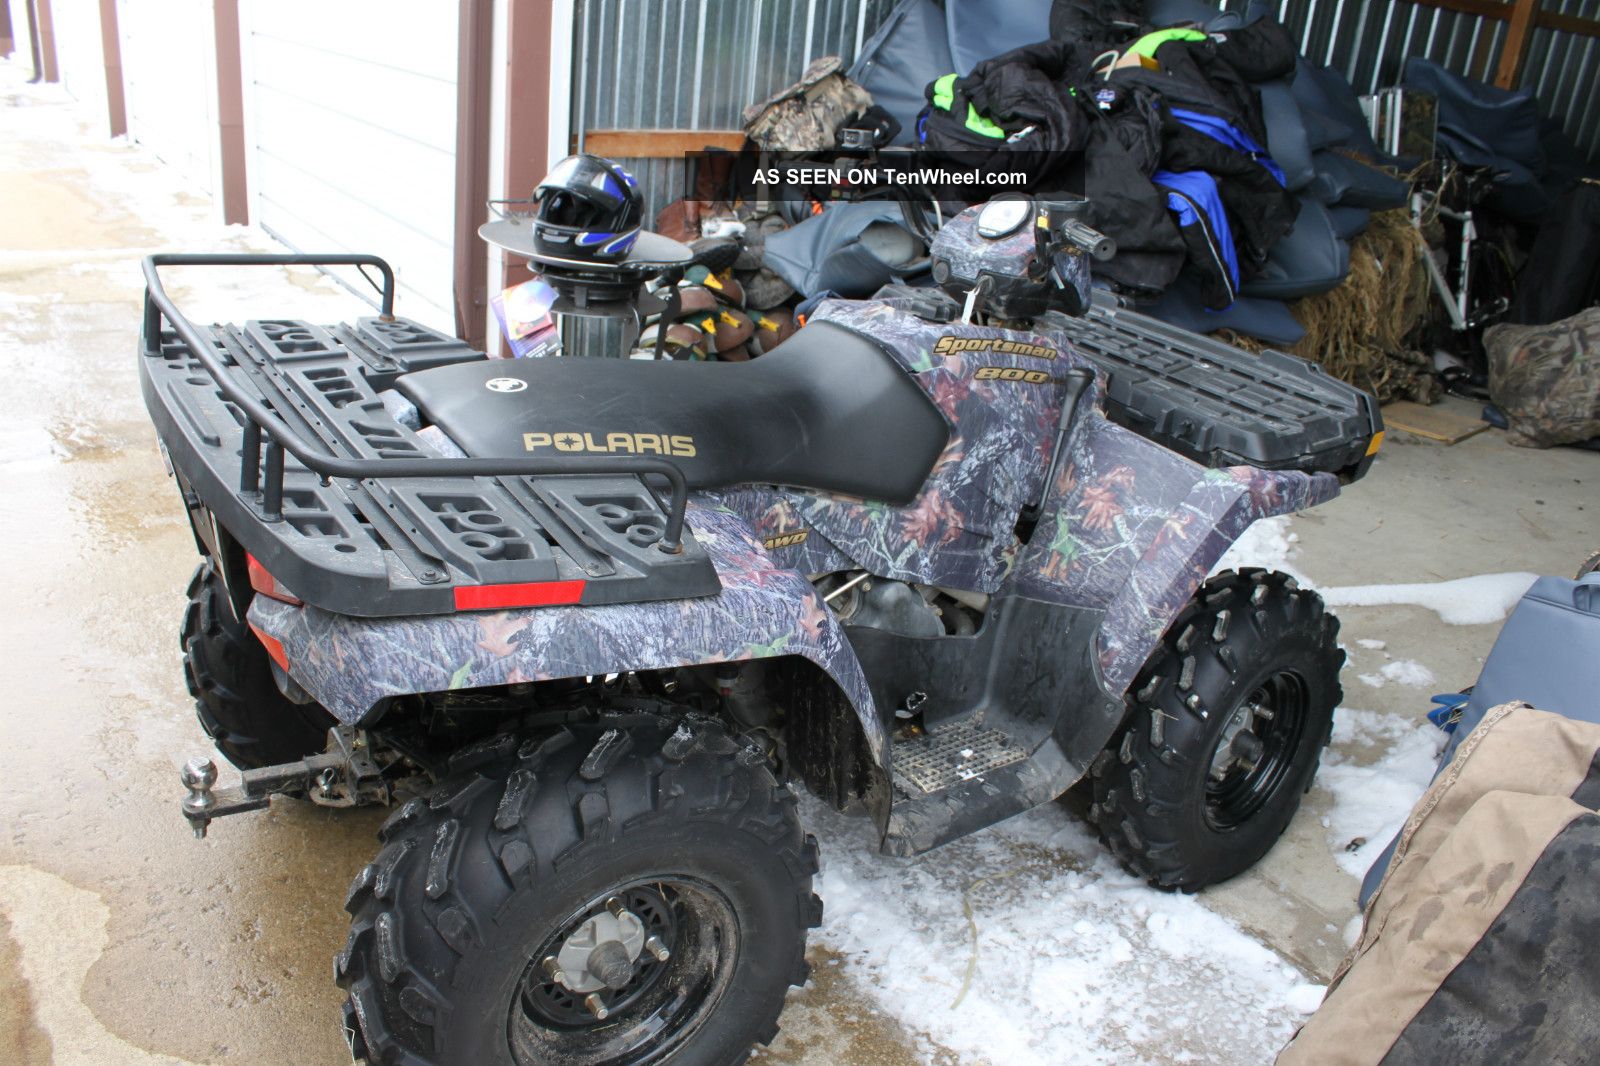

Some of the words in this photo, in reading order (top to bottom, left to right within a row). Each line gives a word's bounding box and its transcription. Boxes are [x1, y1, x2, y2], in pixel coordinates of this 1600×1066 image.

[933, 336, 1057, 361] Sportsman
[974, 367, 1049, 384] 800
[522, 432, 697, 458] POLARIS
